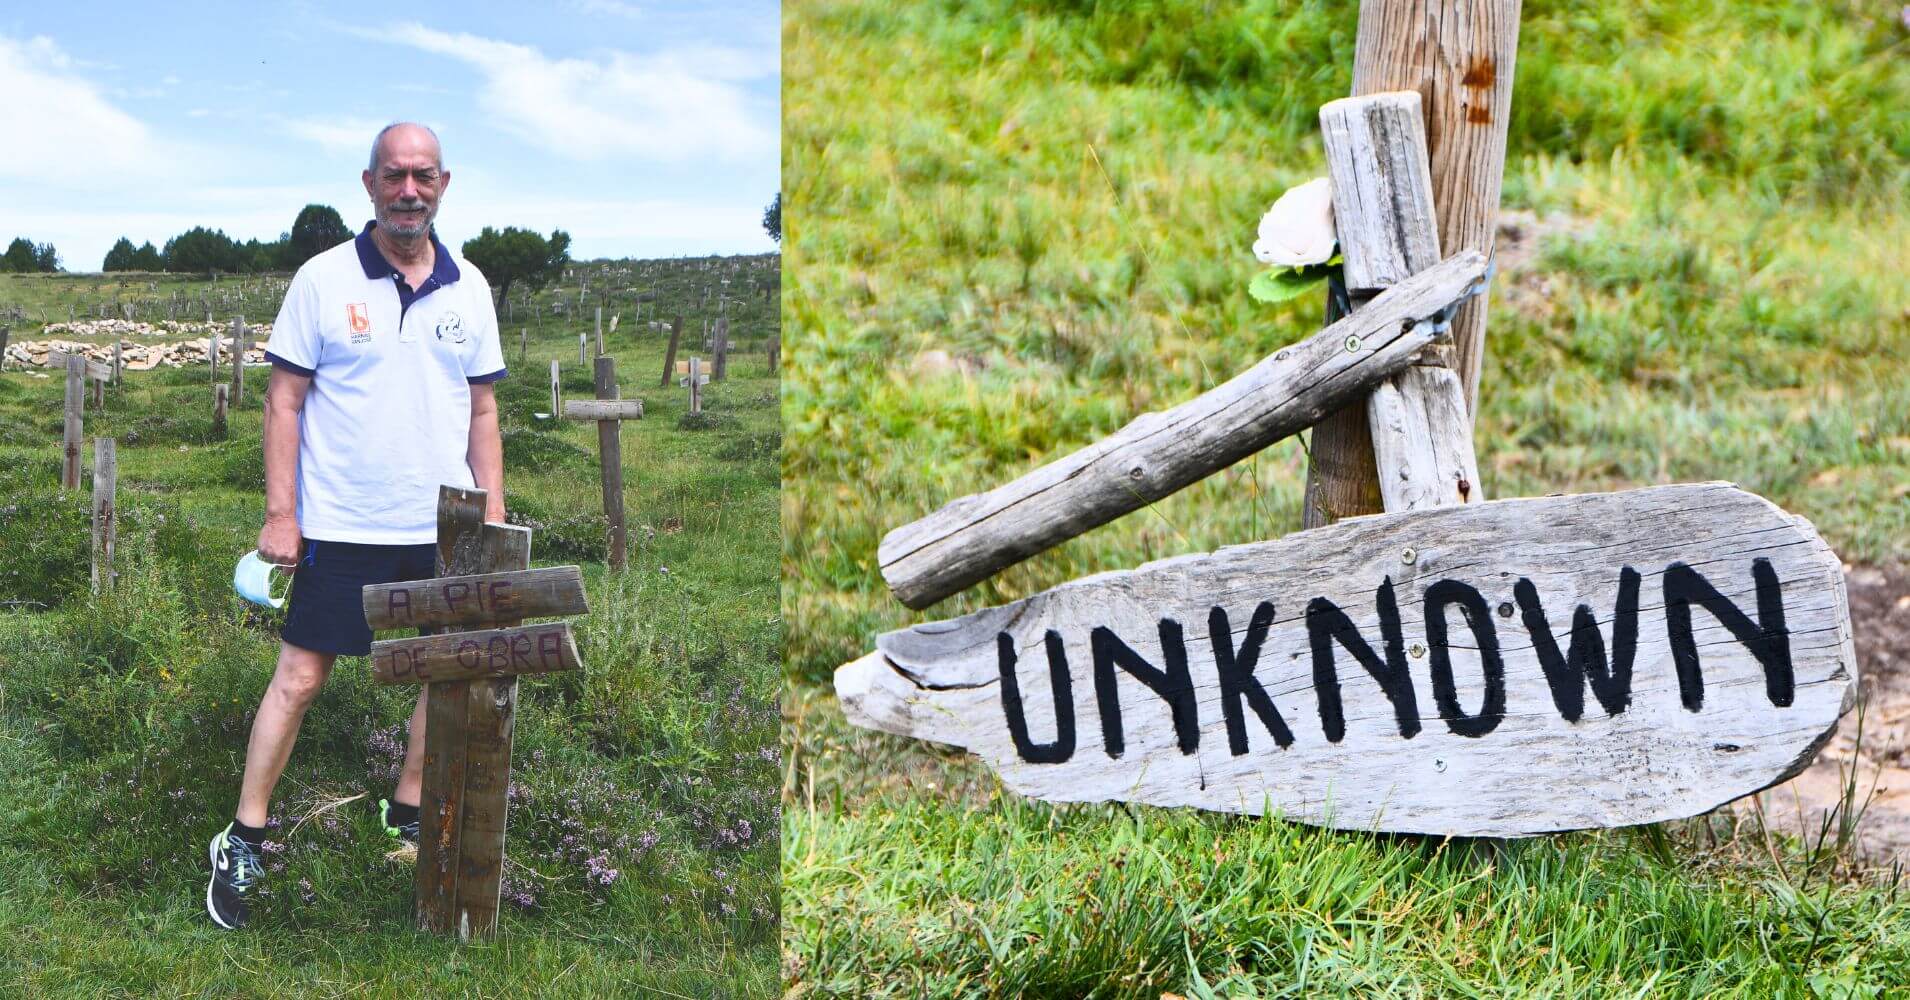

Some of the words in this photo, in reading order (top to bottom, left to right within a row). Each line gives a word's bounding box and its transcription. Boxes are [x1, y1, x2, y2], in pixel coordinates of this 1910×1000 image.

[388, 588, 413, 621] A
[391, 645, 431, 679] DE
[457, 631, 566, 670] OBRA
[997, 556, 1795, 764] UNKNOWN
